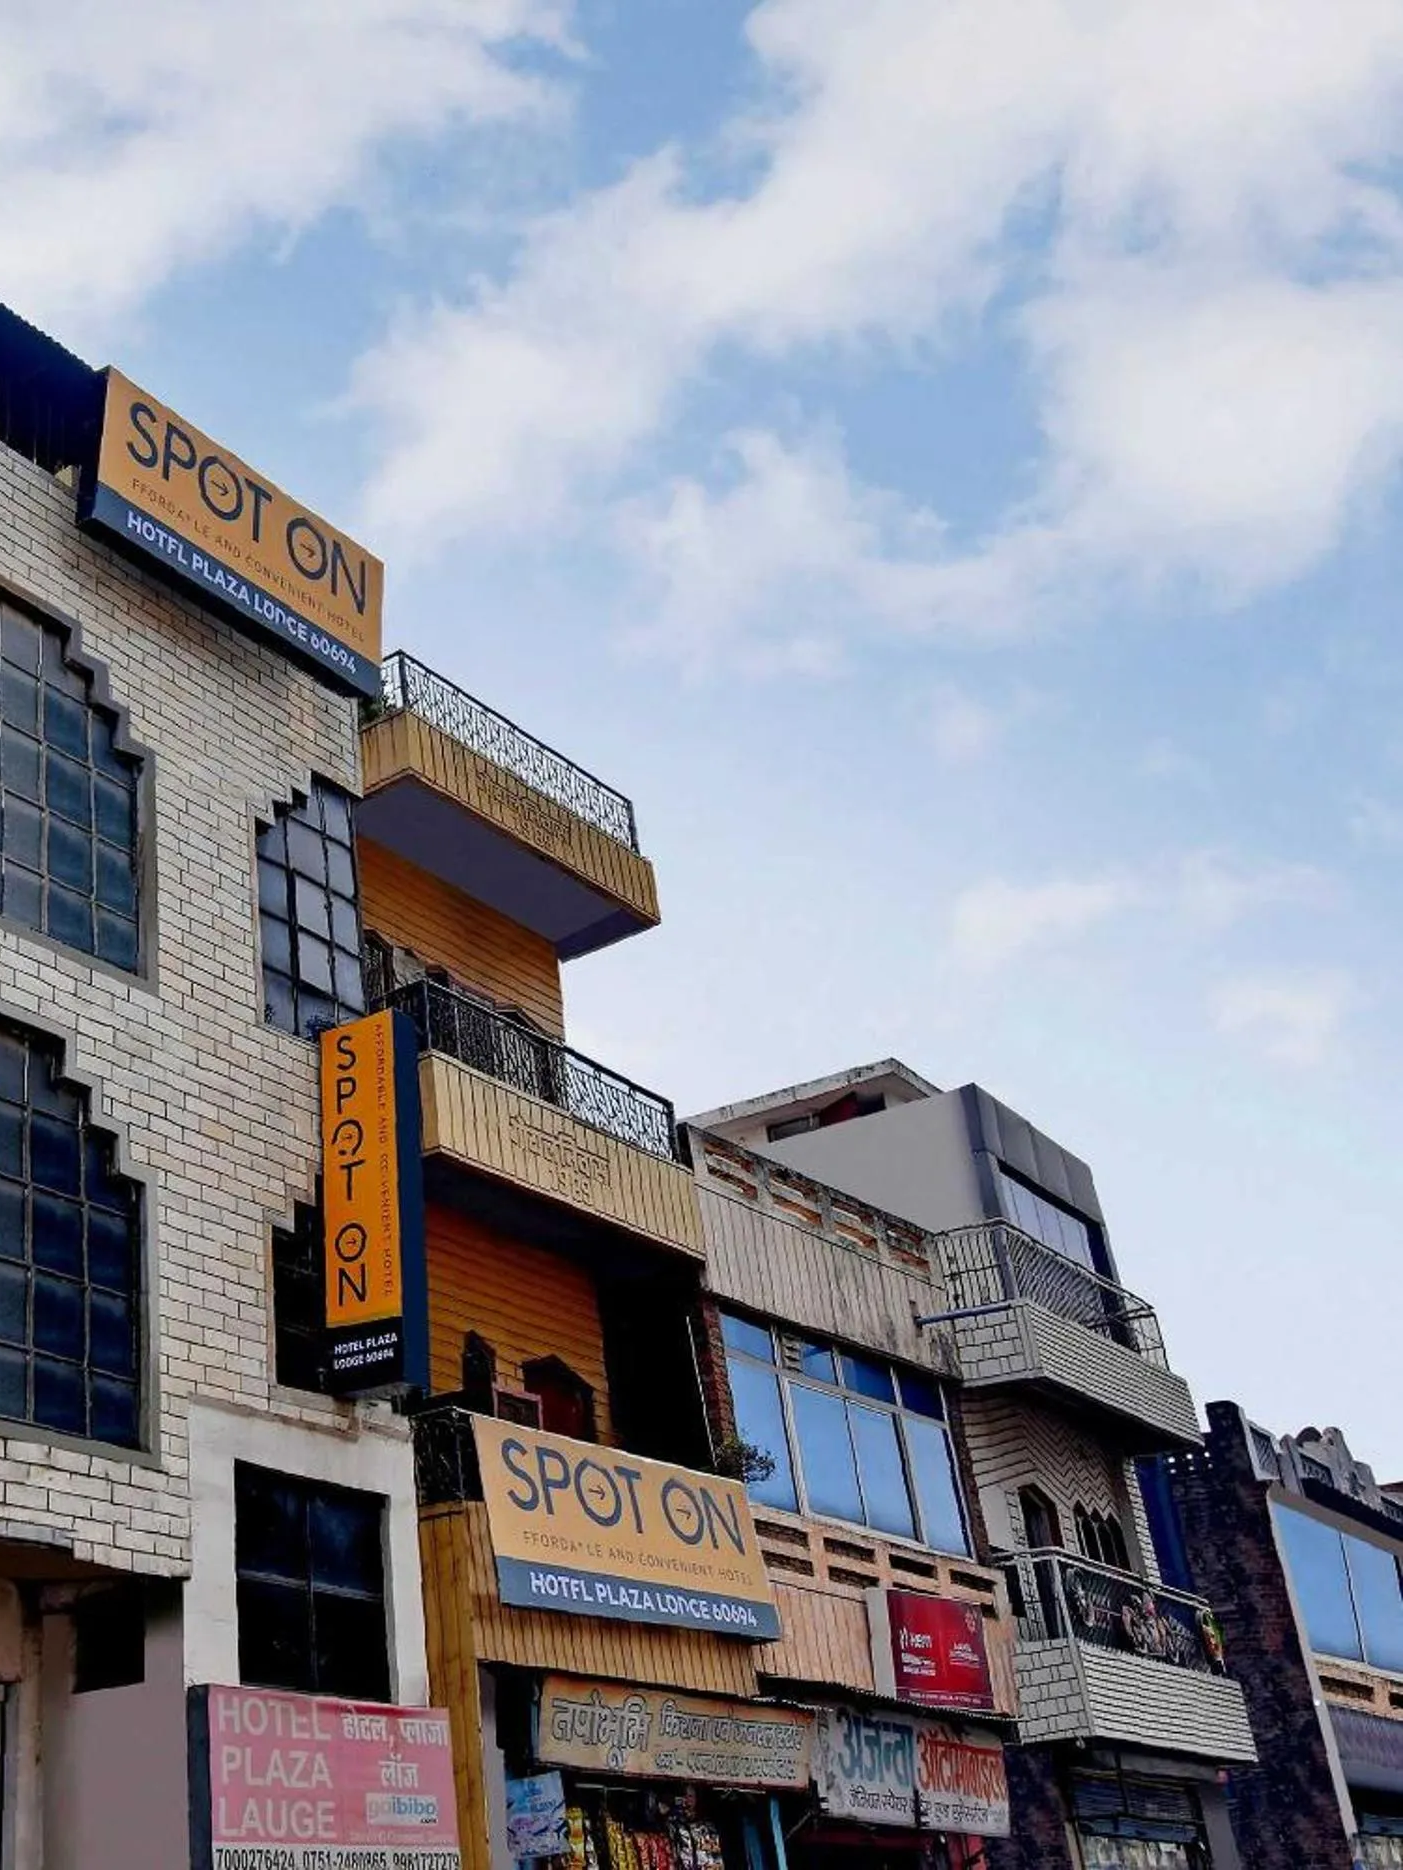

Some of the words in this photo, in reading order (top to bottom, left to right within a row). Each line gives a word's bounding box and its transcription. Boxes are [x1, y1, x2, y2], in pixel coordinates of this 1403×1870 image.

[126, 401, 272, 544] SPOT
[286, 517, 365, 616] ON
[191, 553, 250, 605] PLAZA
[310, 633, 356, 674] 60694
[331, 1035, 365, 1202] SPOT
[334, 1222, 368, 1307] ON
[333, 1354, 364, 1369] LODGE
[334, 1340, 365, 1355] HOTEL
[366, 1332, 398, 1348] PLAZA
[501, 1438, 643, 1534] SPOT
[661, 1478, 746, 1555] ON
[609, 1547, 634, 1564] AND
[595, 1581, 655, 1611] PLAZA
[712, 1602, 757, 1627] 60694
[217, 1694, 332, 1741] HOTEL
[221, 1746, 334, 1790] PLAZA
[218, 1796, 338, 1839] LAUGE
